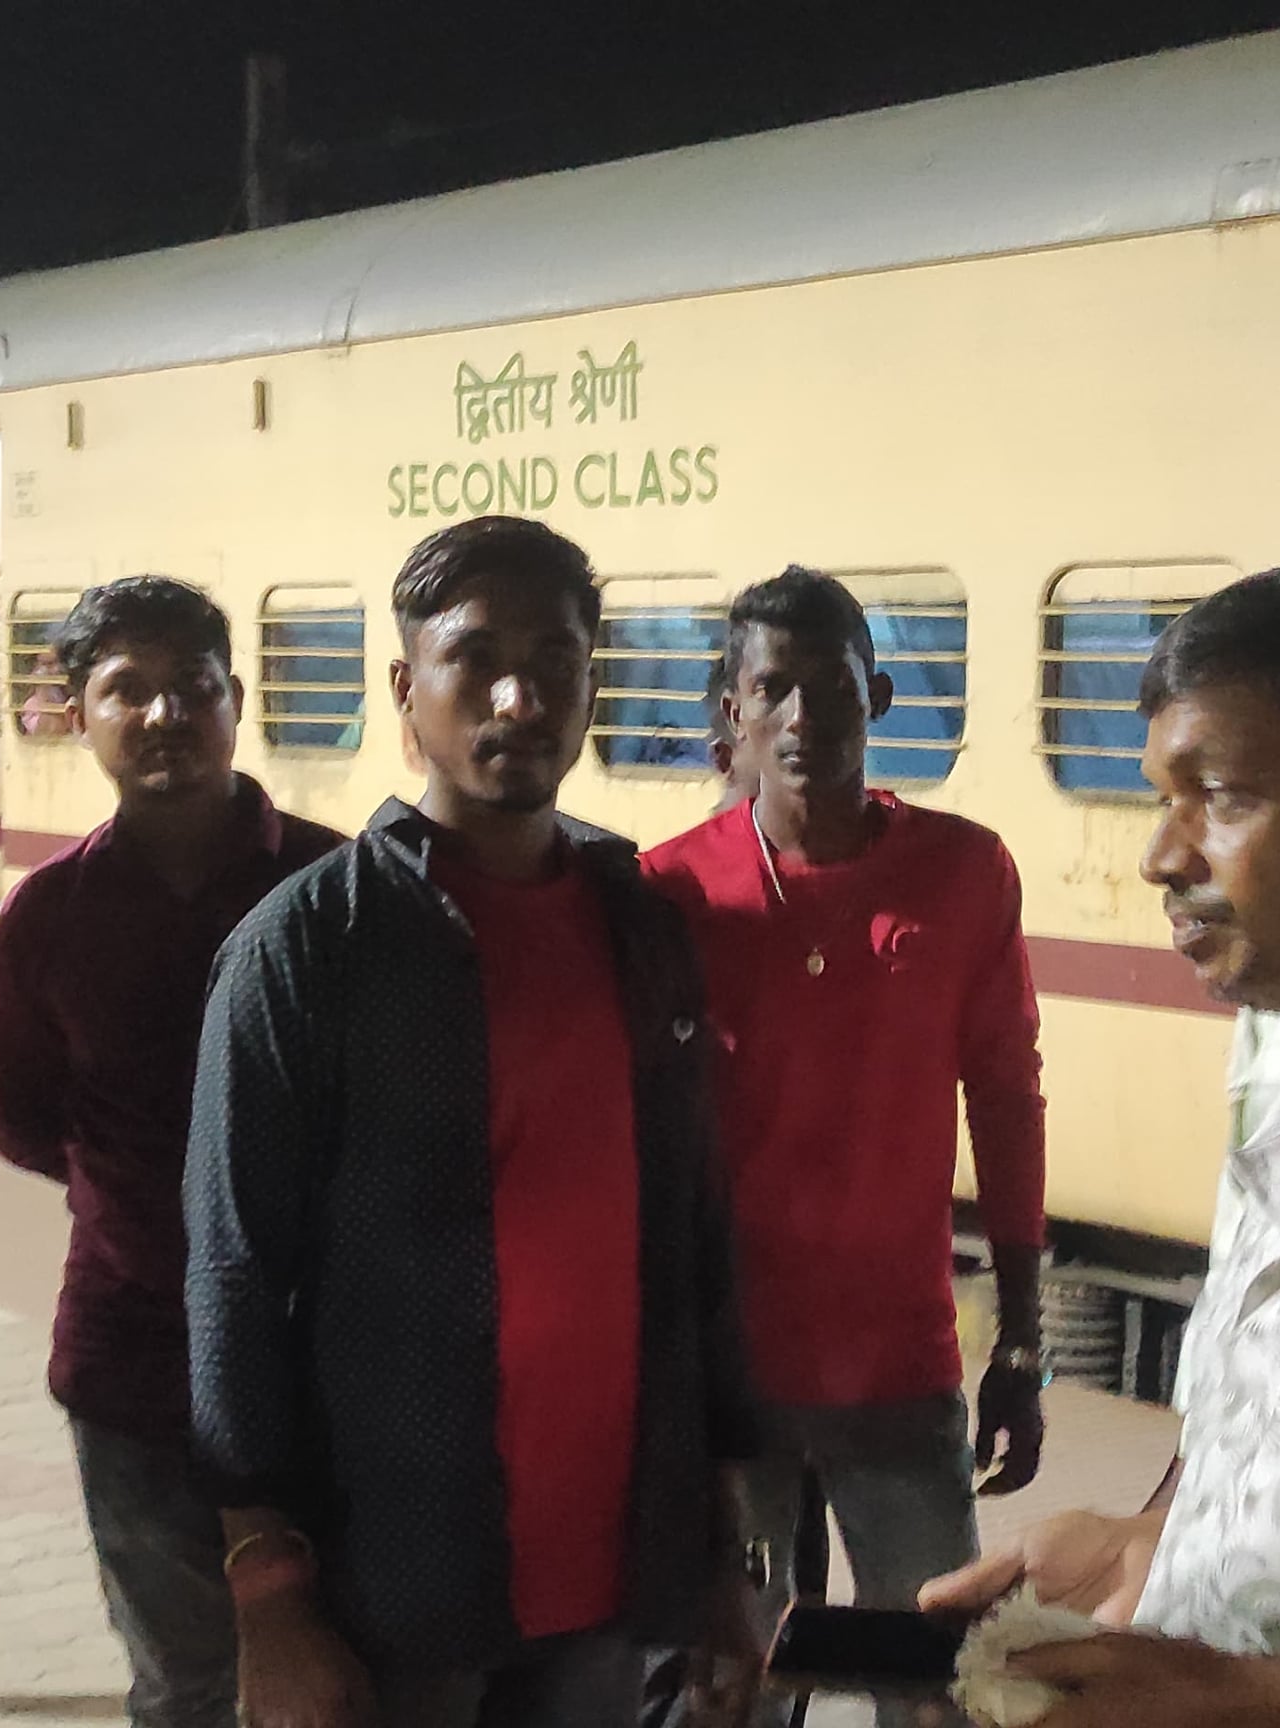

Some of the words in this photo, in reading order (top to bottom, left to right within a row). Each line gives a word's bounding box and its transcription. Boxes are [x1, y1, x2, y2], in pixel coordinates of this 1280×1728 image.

[454, 352, 558, 444] द्वितीय
[569, 339, 644, 426] श्रेणी
[387, 457, 558, 518] SECOND
[573, 445, 719, 509] CLASS
